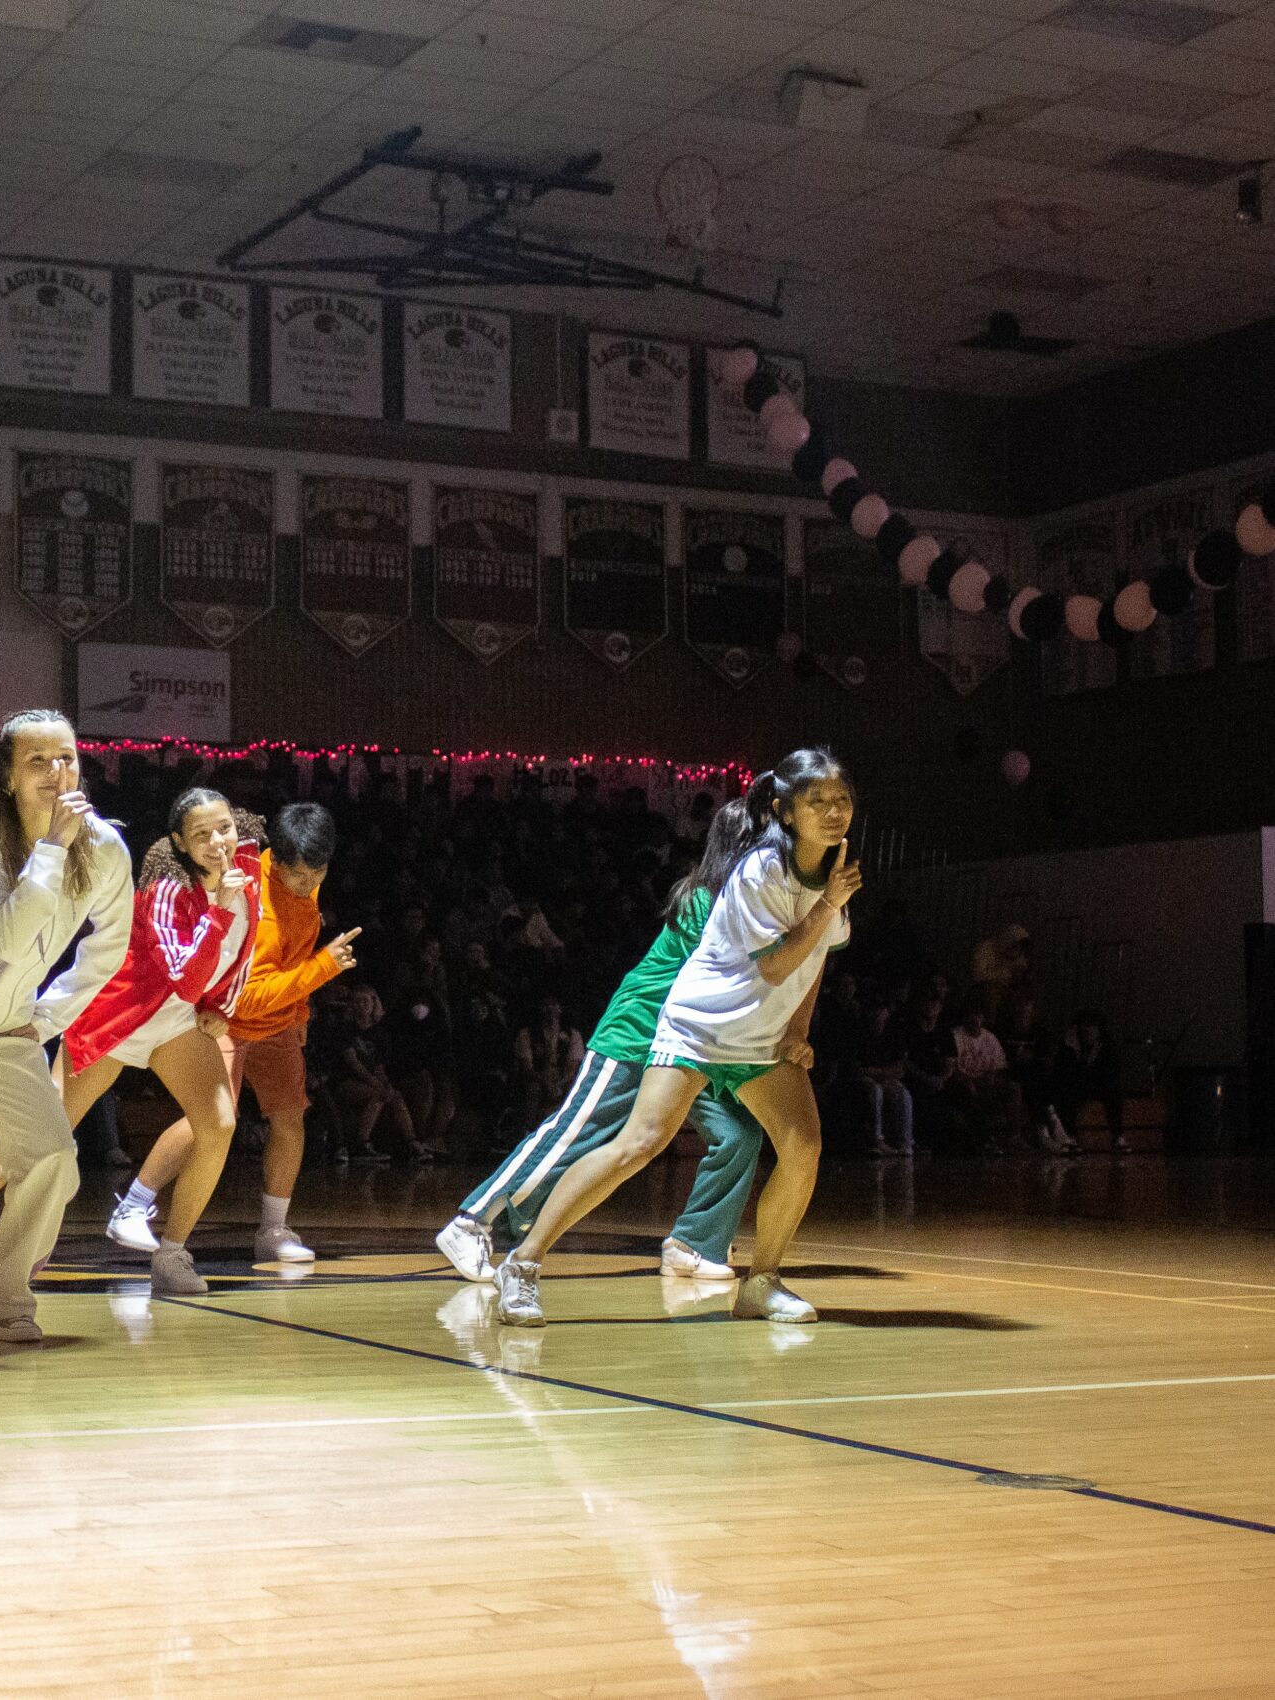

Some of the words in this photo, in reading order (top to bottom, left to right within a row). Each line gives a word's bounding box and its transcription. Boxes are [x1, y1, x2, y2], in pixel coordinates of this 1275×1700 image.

[60, 270, 109, 308] HILLS
[138, 283, 197, 312] LAGUNA
[200, 286, 246, 320] HILLS
[274, 297, 336, 325] LAGUNA
[337, 300, 379, 335] HILLS
[407, 312, 462, 339] LAGUNA
[466, 314, 506, 350] HILLS
[129, 671, 226, 699] Simpson
